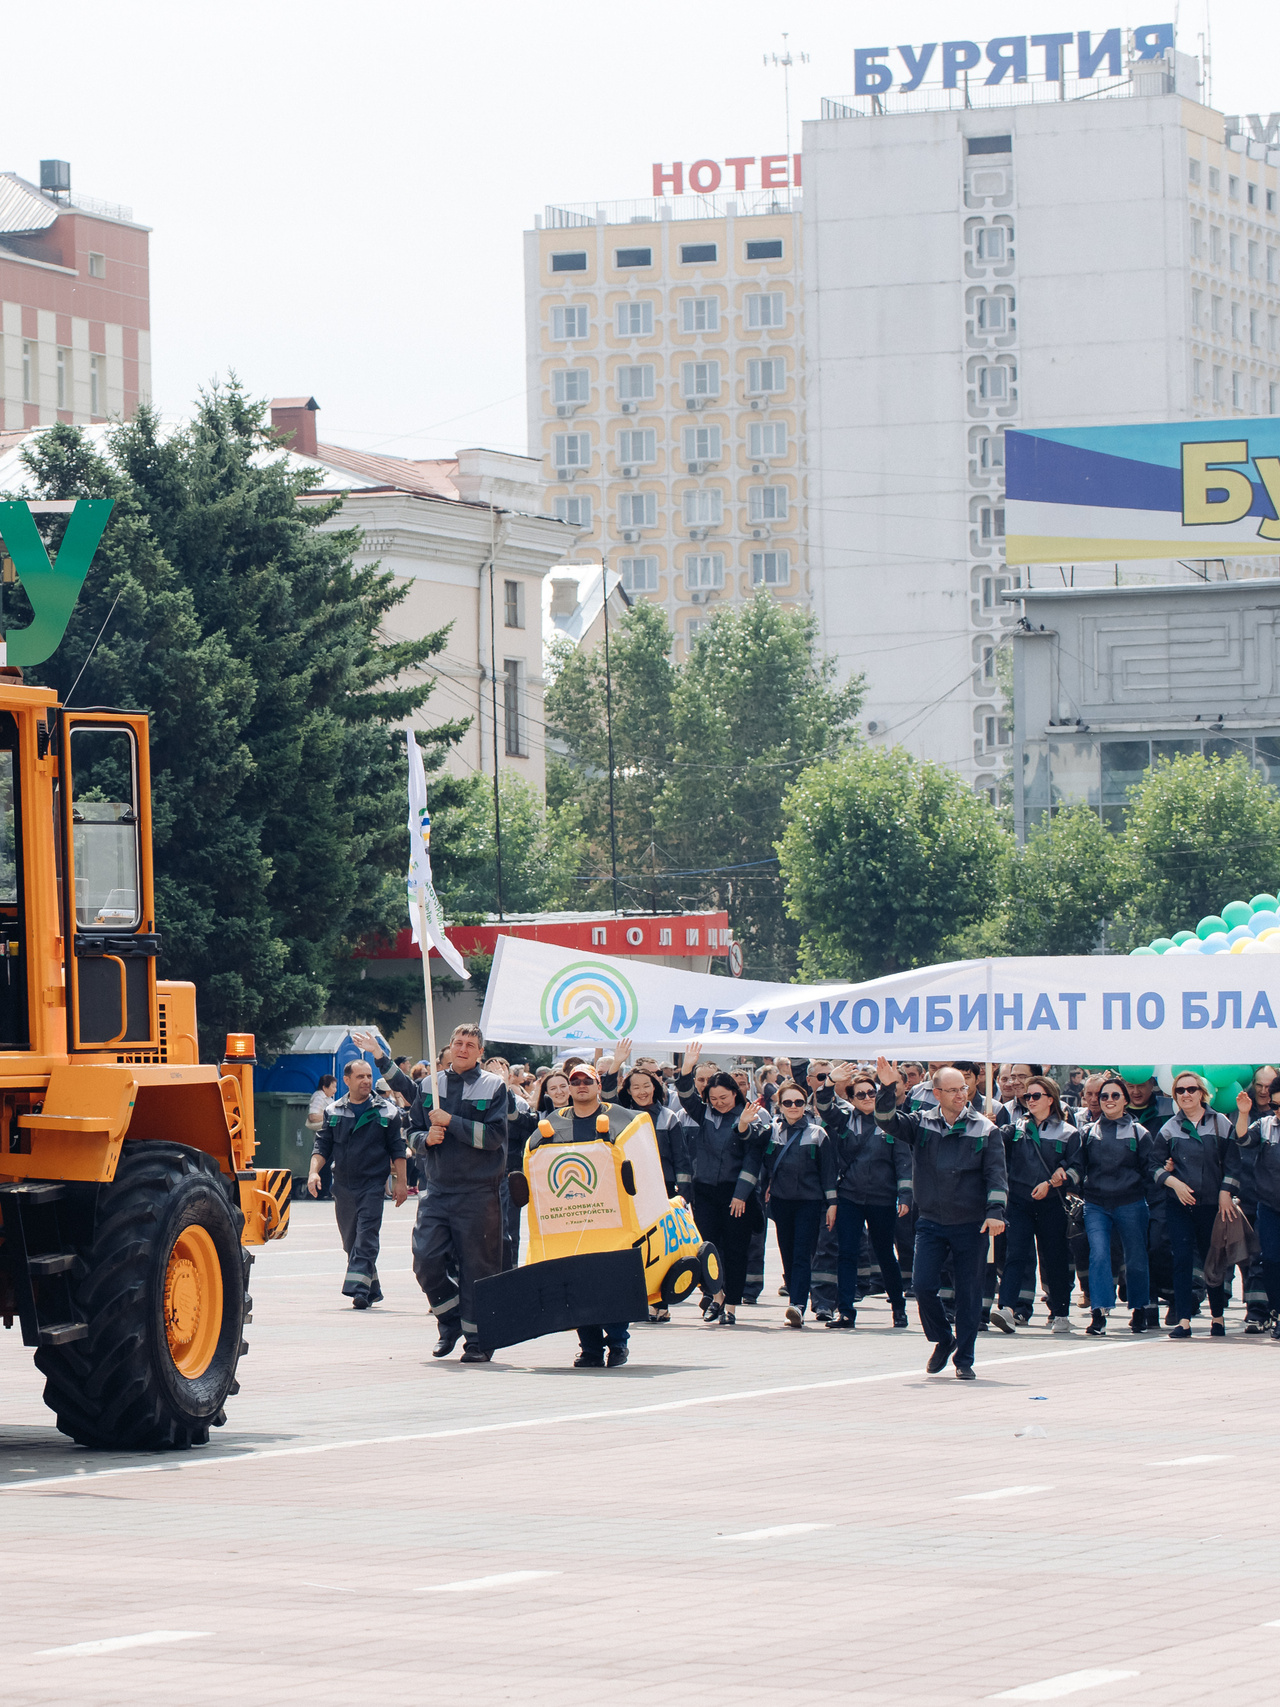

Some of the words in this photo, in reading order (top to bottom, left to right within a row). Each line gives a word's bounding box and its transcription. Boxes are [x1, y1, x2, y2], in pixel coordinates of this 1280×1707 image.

[854, 23, 1173, 95] БУРЯТИЯ
[668, 1003, 769, 1035] МБУ
[784, 992, 1087, 1035] «КОМБИНАТ
[1102, 991, 1166, 1031] ПО
[1181, 990, 1278, 1031] БЛА
[549, 1205, 563, 1213] МБУ
